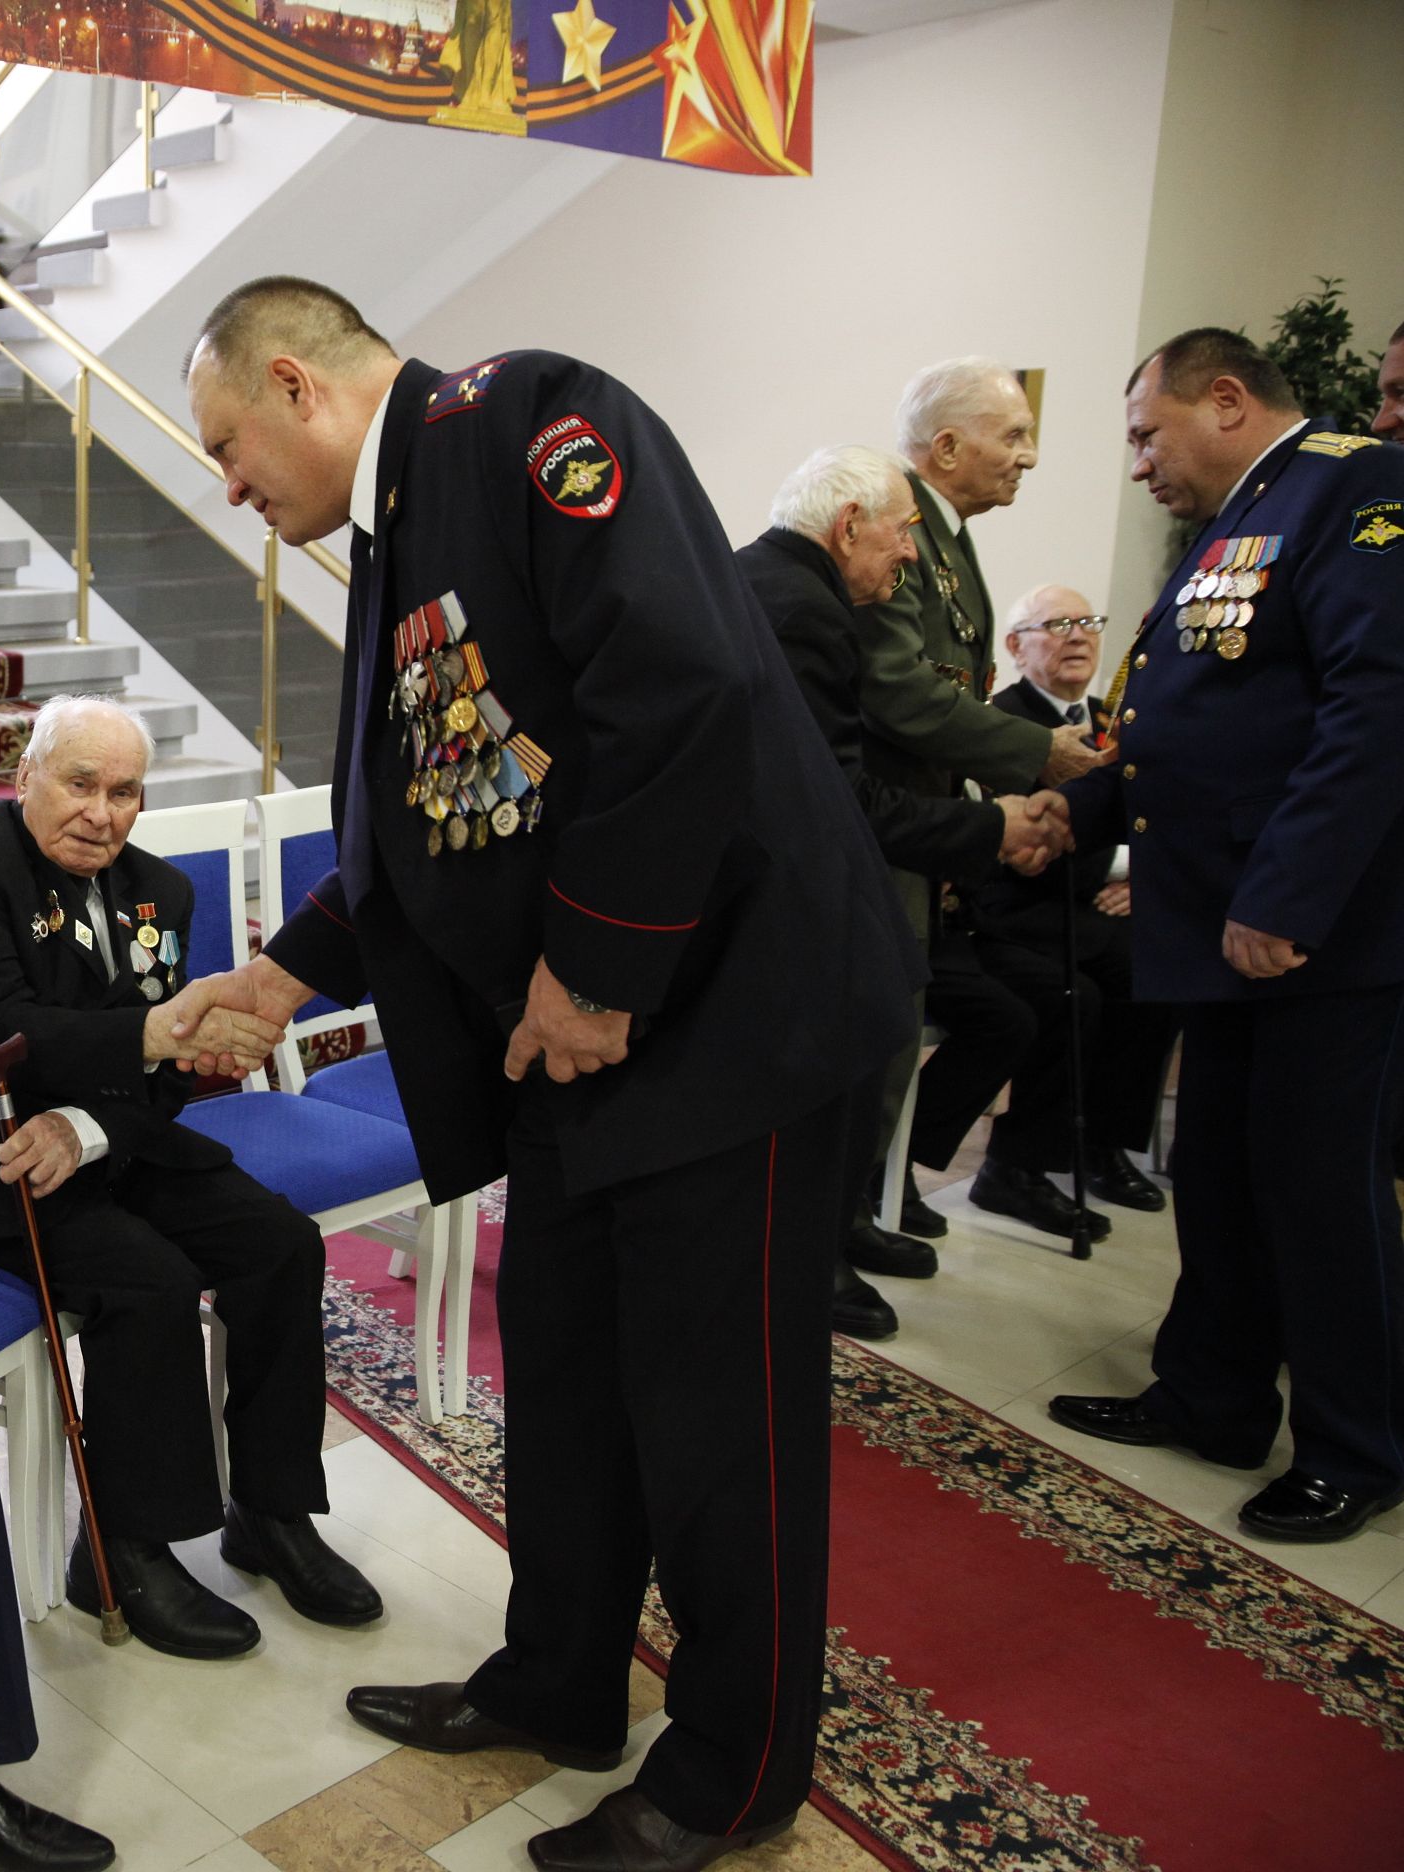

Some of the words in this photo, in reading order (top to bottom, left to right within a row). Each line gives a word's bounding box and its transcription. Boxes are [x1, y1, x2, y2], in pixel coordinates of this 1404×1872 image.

[527, 418, 582, 464] ПОЛИЦИЯ
[540, 436, 596, 482] РОССИЯ
[1356, 503, 1401, 518] РОССИЯ
